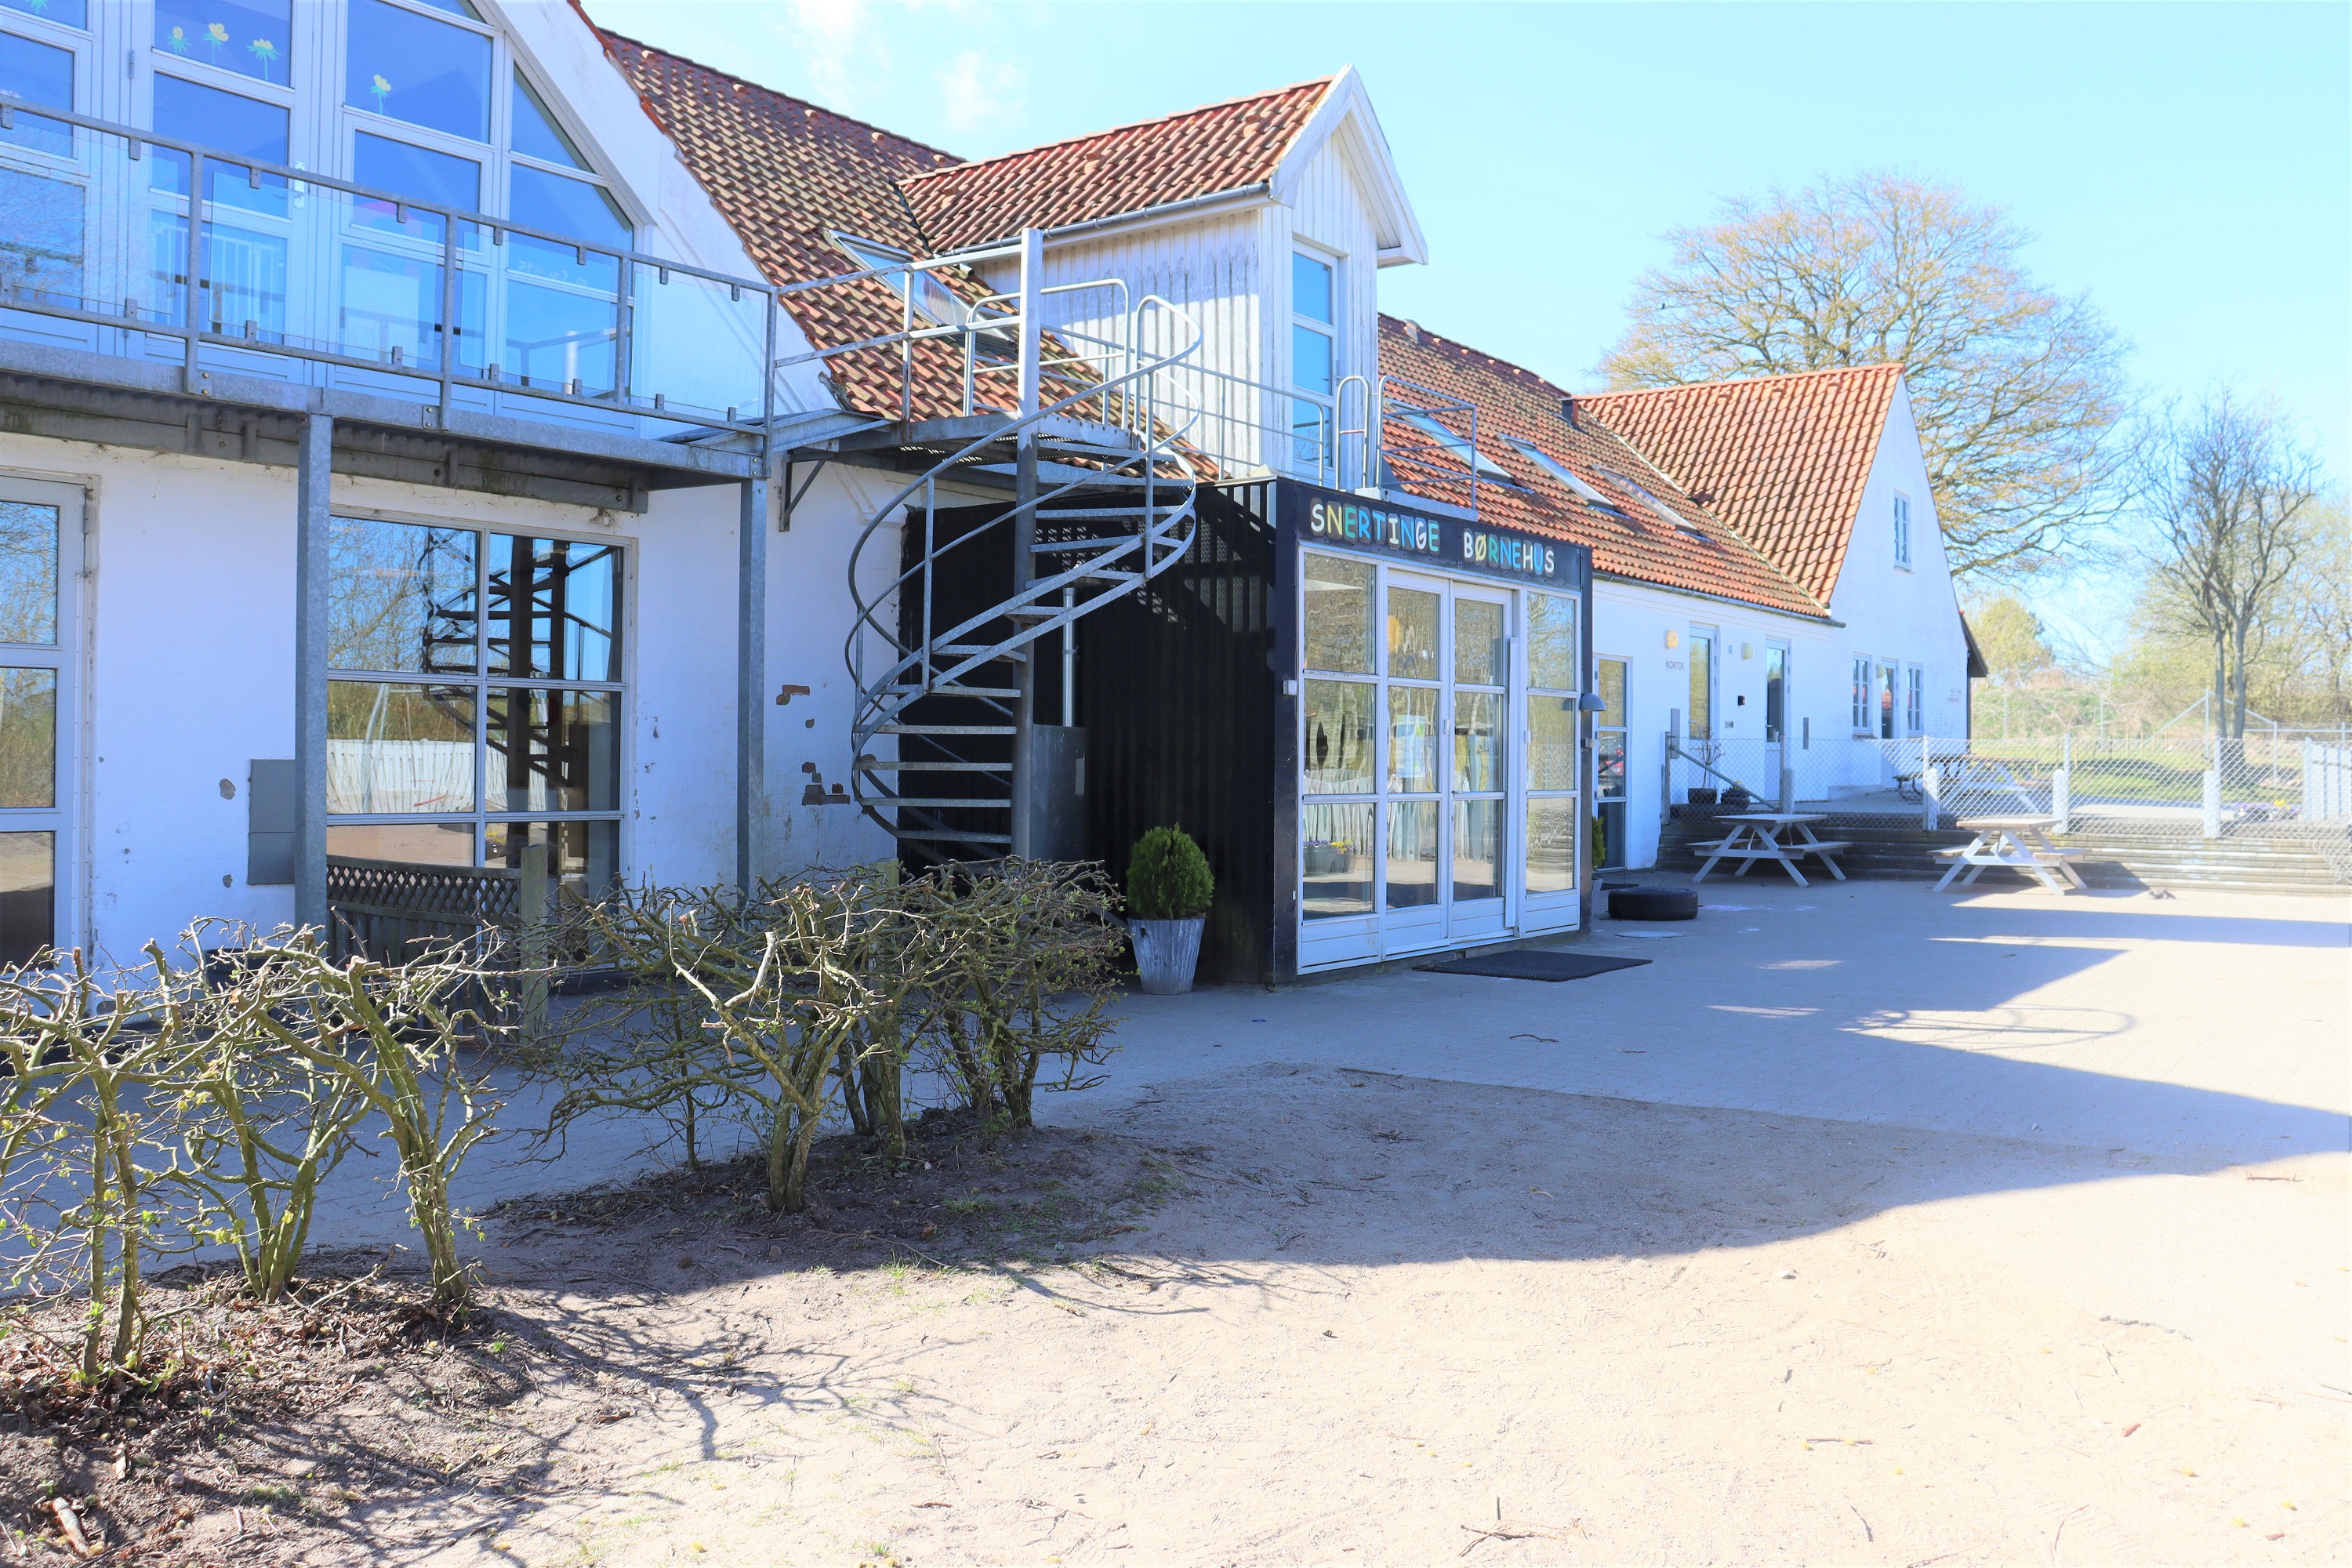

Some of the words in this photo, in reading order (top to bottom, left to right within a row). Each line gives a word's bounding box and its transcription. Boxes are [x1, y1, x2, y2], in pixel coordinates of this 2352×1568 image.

[1310, 503, 1439, 552] SNERTINGE
[1464, 532, 1555, 573] BØRNEHUS
[1666, 659, 1685, 670] KONTOR
